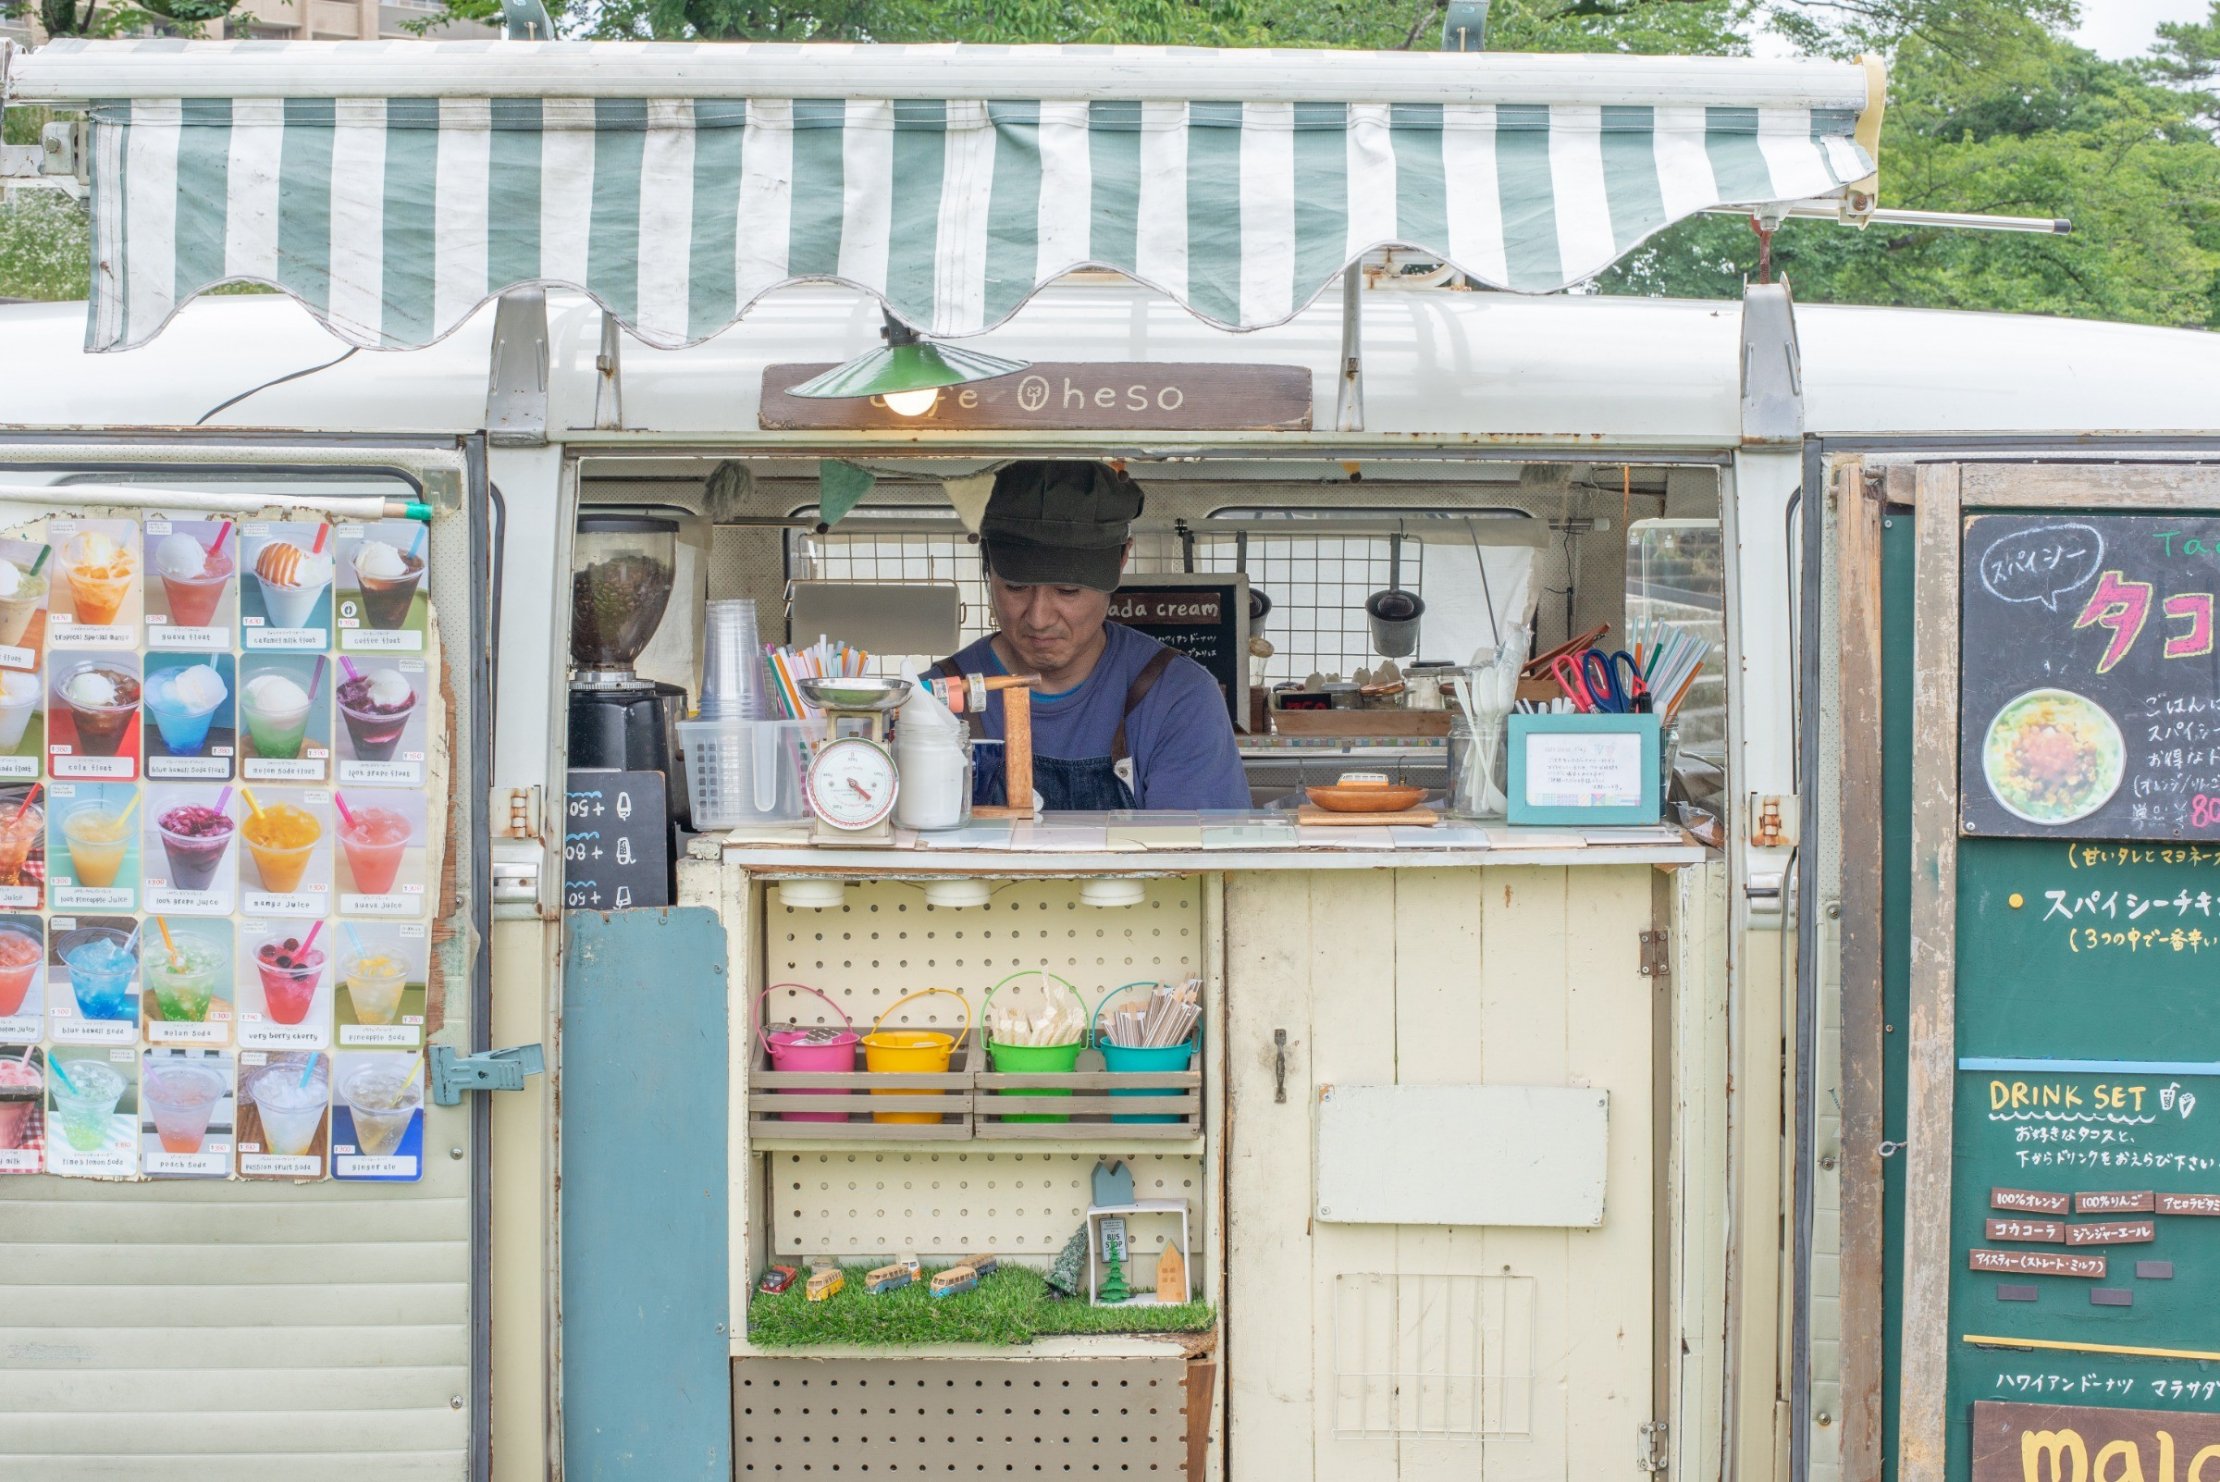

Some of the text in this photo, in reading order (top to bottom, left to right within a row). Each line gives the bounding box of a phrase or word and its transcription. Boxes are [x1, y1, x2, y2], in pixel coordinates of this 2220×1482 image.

[2152, 531, 2220, 558] Ta
[1992, 545, 2086, 584] スパイシー
[1108, 599, 1219, 618] ada cream
[2072, 570, 2214, 675] タコ
[2043, 888, 2220, 922] スパイシーチキ
[1990, 1080, 2147, 1112] DRINK SET
[2015, 1150, 2220, 1172] 下からドリンクをおえらび下さい
[1997, 1193, 2065, 1209] 100%オレンジ
[2082, 1194, 2143, 1208] 100%りんご
[1995, 1222, 2057, 1239] コカコーラ
[2073, 1227, 2151, 1241] ジンジャーエール
[1996, 1373, 2134, 1396] ハワイアンドーナツ
